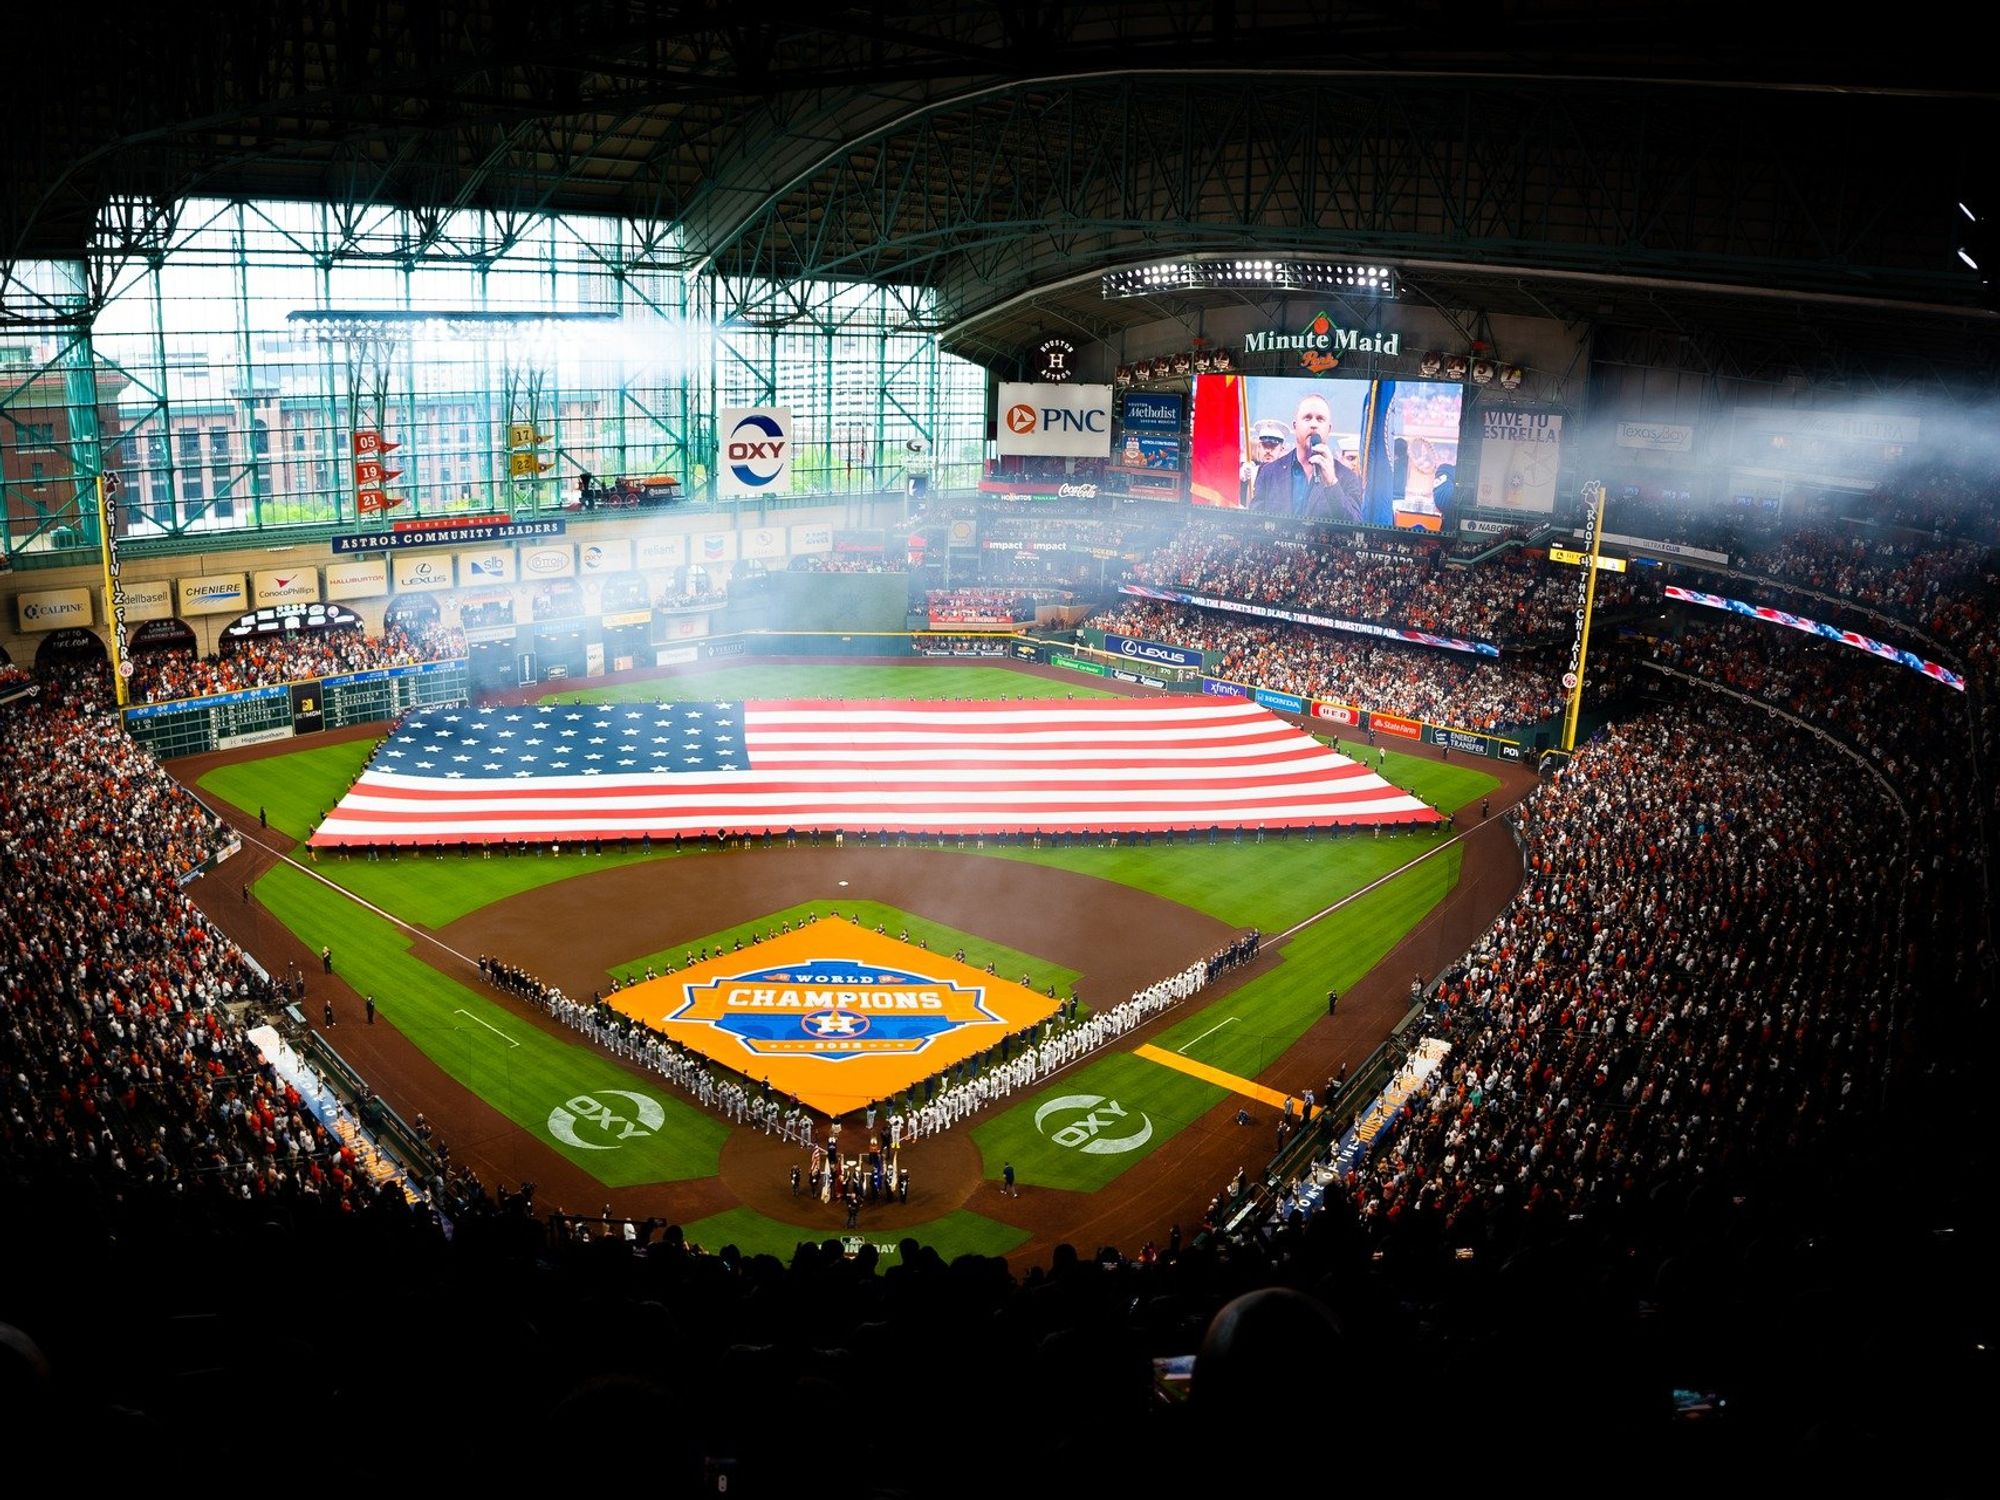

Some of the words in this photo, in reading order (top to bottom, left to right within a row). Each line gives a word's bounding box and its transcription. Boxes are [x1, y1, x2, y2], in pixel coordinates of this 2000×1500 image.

[1040, 340, 1074, 352] HOUSTON
[1244, 331, 1330, 353] Minute
[1334, 329, 1400, 356] Maid
[1048, 353, 1065, 368] H
[1041, 369, 1071, 380] ASTROS
[1128, 405, 1177, 419] Methodist
[1040, 408, 1106, 433] PNC
[1528, 414, 1549, 428] TU
[516, 430, 529, 442] 17
[1621, 422, 1657, 439] Texas
[1658, 426, 1690, 445] Bay
[360, 436, 375, 449] 05
[728, 442, 785, 460] OXY
[516, 460, 530, 470] 22
[363, 466, 377, 479] 19
[1058, 483, 1099, 499] Coca-Cola
[363, 494, 377, 506] 21
[341, 535, 398, 549] ASTROS
[403, 528, 494, 544] COMMUNITY
[499, 522, 558, 536] LEADERS
[989, 541, 1023, 551] impact
[1033, 542, 1067, 551] impact
[484, 556, 504, 569] slb
[584, 554, 602, 562] OXY
[329, 575, 384, 585] HALLIBURTON
[401, 575, 448, 586] LEXUS
[186, 583, 241, 597] CHENIERE
[258, 586, 315, 599] ConocoPhillips
[40, 603, 84, 616] CALPINE
[1206, 598, 1219, 608] THE
[1293, 613, 1308, 624] THE
[1138, 645, 1185, 663] LEXUS
[1210, 682, 1240, 696] xfinity
[1264, 695, 1300, 709] HONDA
[1450, 732, 1478, 743] ENERGY
[1450, 740, 1485, 753] TRANSFER
[796, 974, 874, 984] WORLD
[727, 988, 943, 1010] CHAMPIONS
[814, 1042, 862, 1050] 2022
[565, 1095, 652, 1140] OXY
[1051, 1099, 1129, 1148] OXY
